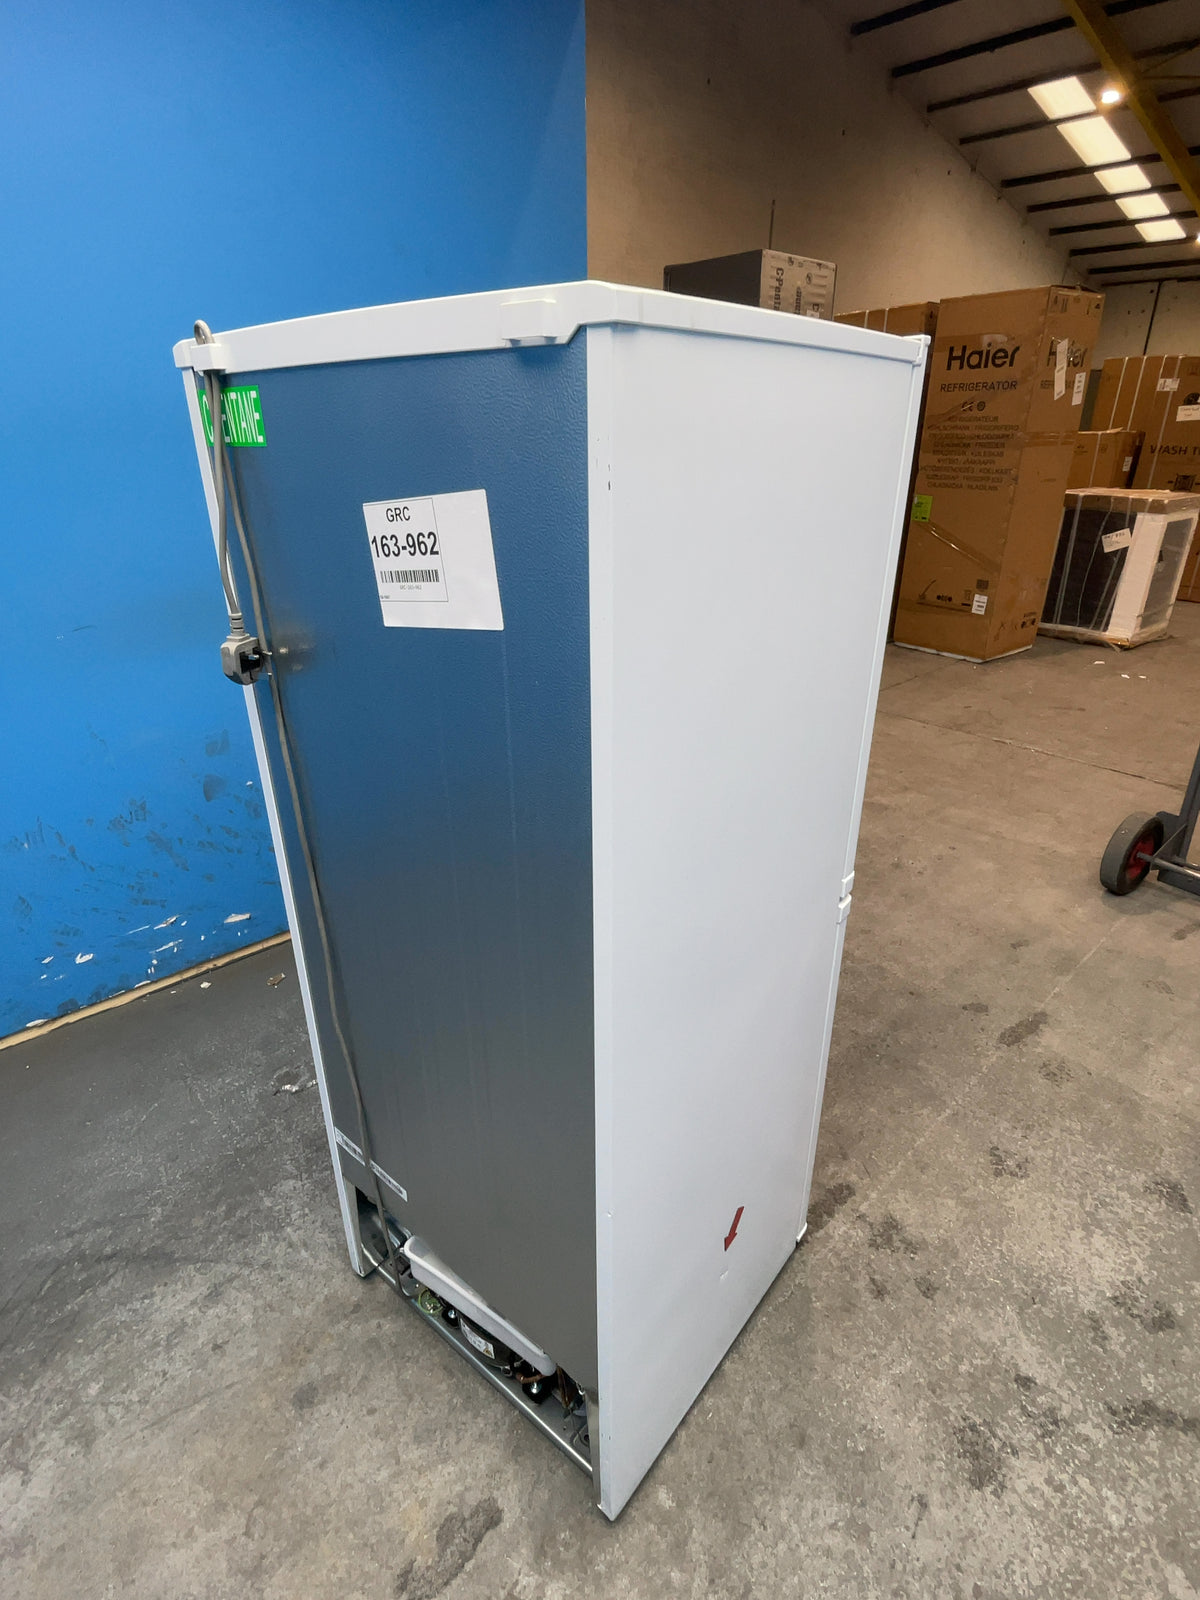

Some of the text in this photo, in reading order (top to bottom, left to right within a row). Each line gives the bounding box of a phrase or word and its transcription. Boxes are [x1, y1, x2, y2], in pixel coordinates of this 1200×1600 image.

[946, 342, 1020, 370] Haier
[1046, 340, 1088, 368] Hier
[940, 380, 1018, 393] REFRIGERATOR
[1150, 444, 1200, 456] WASH T
[386, 506, 411, 523] GRC
[371, 531, 440, 558] 163-962
